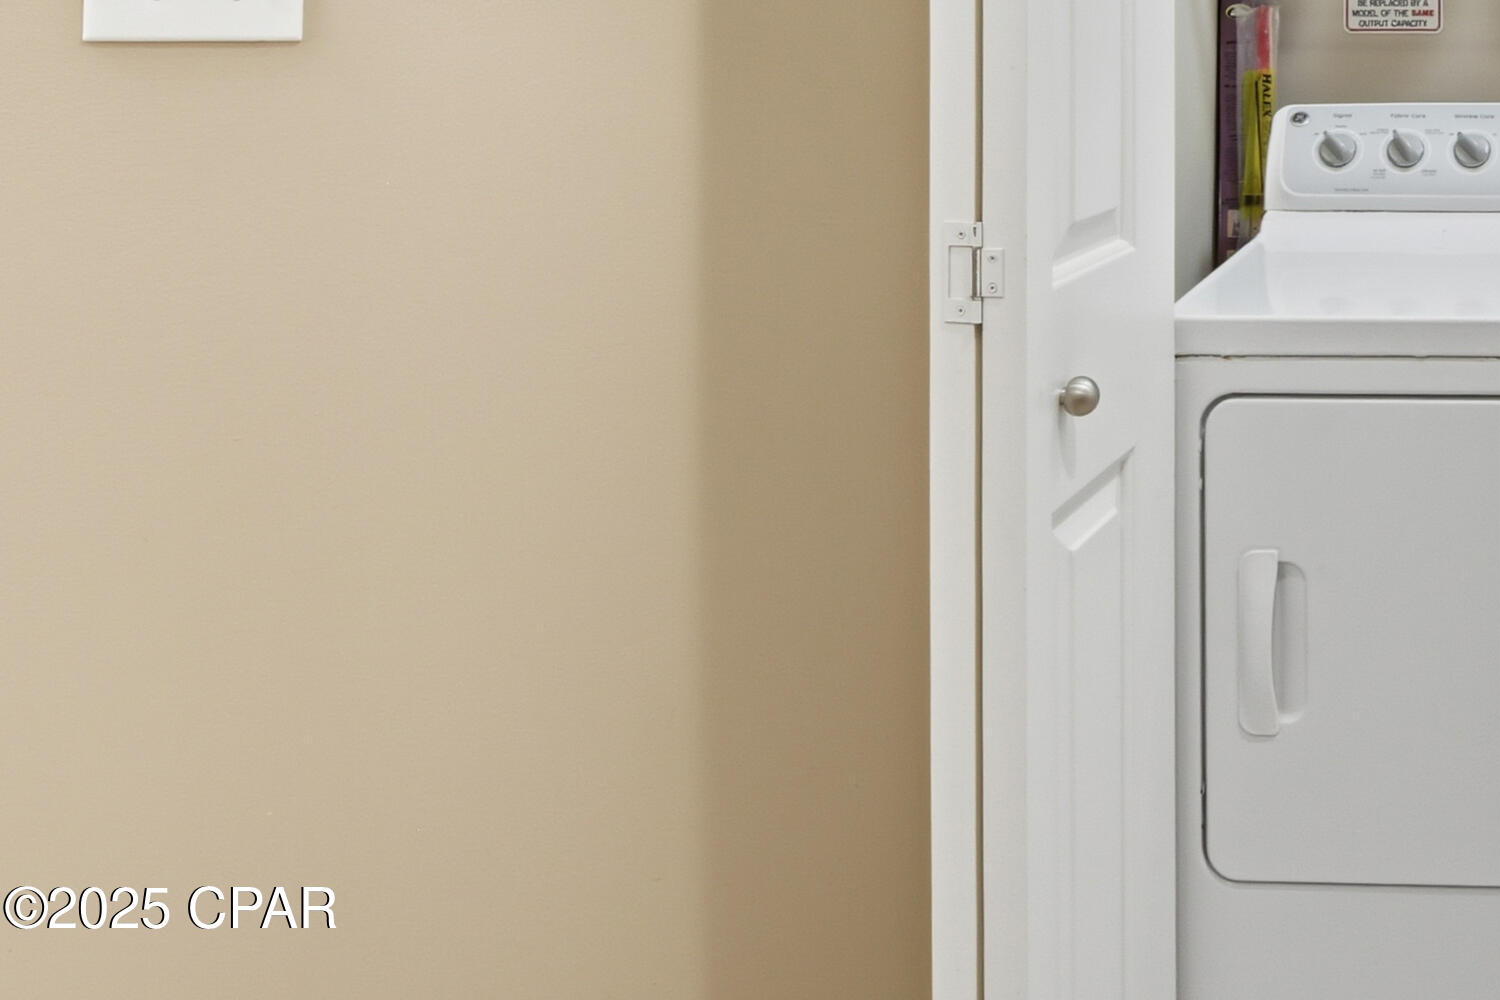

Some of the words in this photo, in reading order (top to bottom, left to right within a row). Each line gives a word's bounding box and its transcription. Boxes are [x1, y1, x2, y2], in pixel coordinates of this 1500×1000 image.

[1357, 0, 1368, 7] BE
[1369, 0, 1409, 7] REPLACED
[1410, 0, 1421, 7] BY
[1422, 0, 1429, 7] A
[1352, 9, 1378, 17] MODEL
[1380, 9, 1391, 17] OF
[1394, 9, 1409, 17] THE
[1411, 9, 1435, 17] SAME
[1358, 19, 1388, 27] OUTPUT
[1391, 19, 1428, 27] CAPACITY
